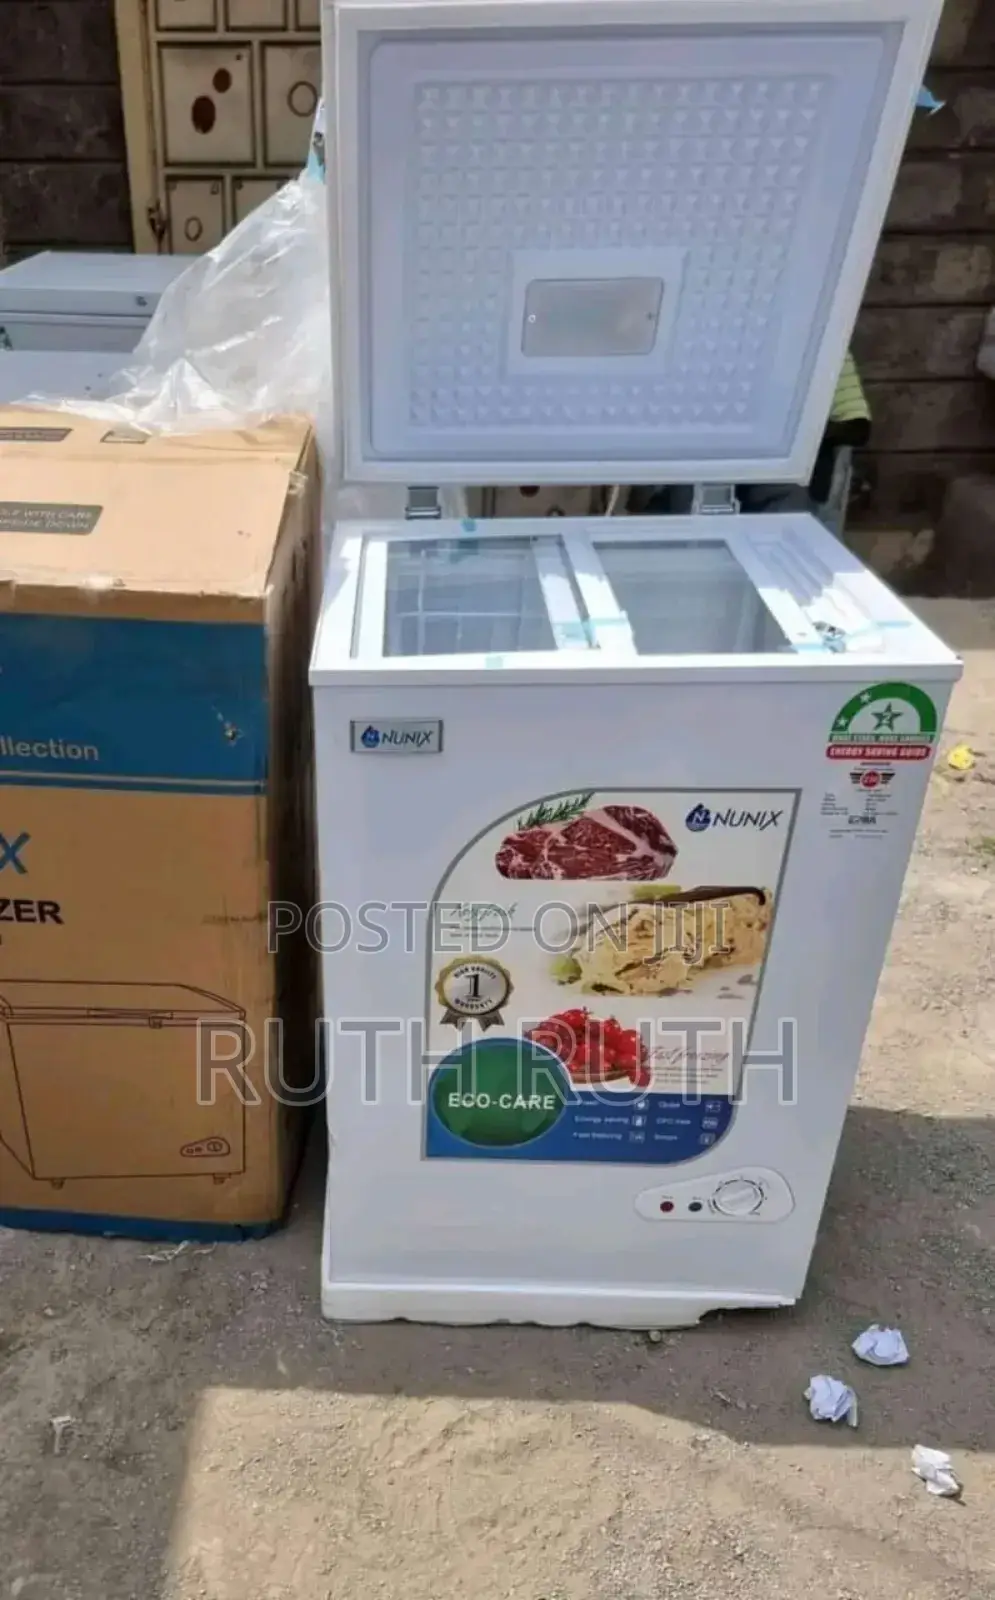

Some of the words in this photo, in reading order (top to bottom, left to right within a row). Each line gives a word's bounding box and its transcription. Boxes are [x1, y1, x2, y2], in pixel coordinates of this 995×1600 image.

[382, 729, 433, 747] NUNIX
[829, 746, 864, 757] ENERGY
[865, 746, 897, 757] SAVING
[712, 808, 783, 831] NUNIX
[0, 898, 65, 926] ZER
[464, 973, 484, 998] 1
[448, 1093, 556, 1111] ECO-CARE
